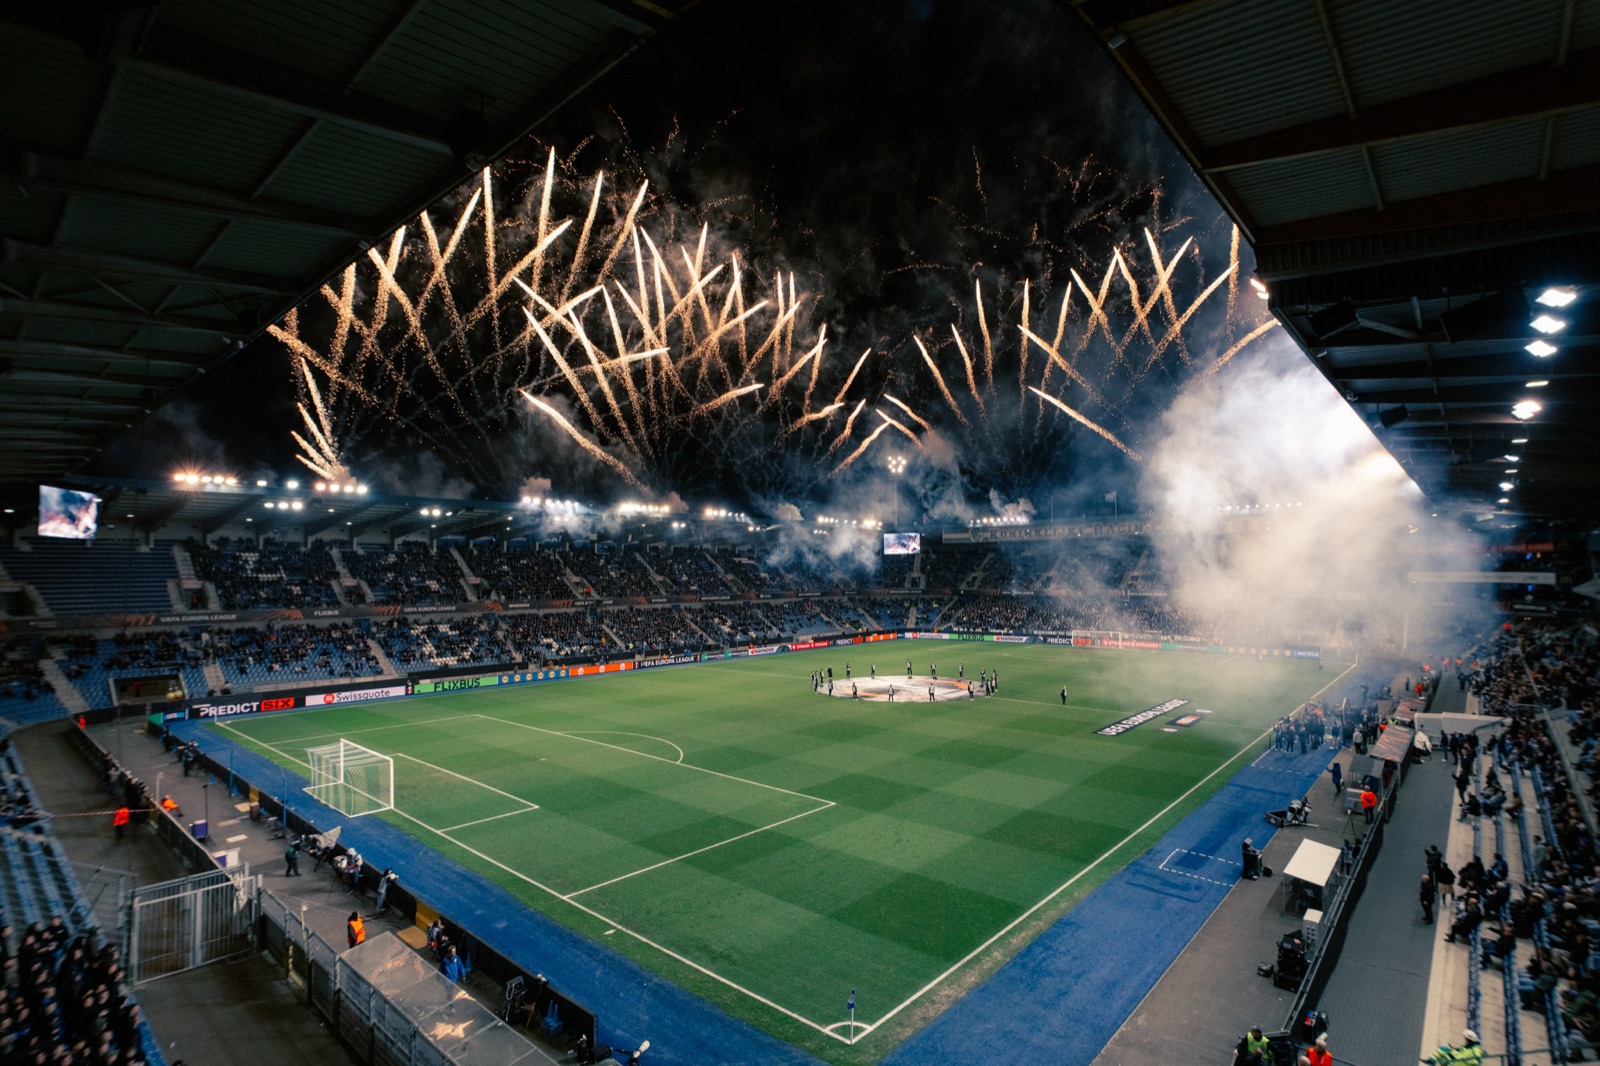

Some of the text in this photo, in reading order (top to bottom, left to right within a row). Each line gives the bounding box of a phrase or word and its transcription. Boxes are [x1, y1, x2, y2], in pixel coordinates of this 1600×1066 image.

[989, 524, 1085, 542] KONINKLIJKE
[1047, 637, 1073, 645] PREDICT
[640, 655, 694, 667] UEFA EUROPA LEAGUE
[336, 689, 391, 703] Swissquote
[199, 702, 260, 718] PREDICT
[263, 699, 292, 712] SIX
